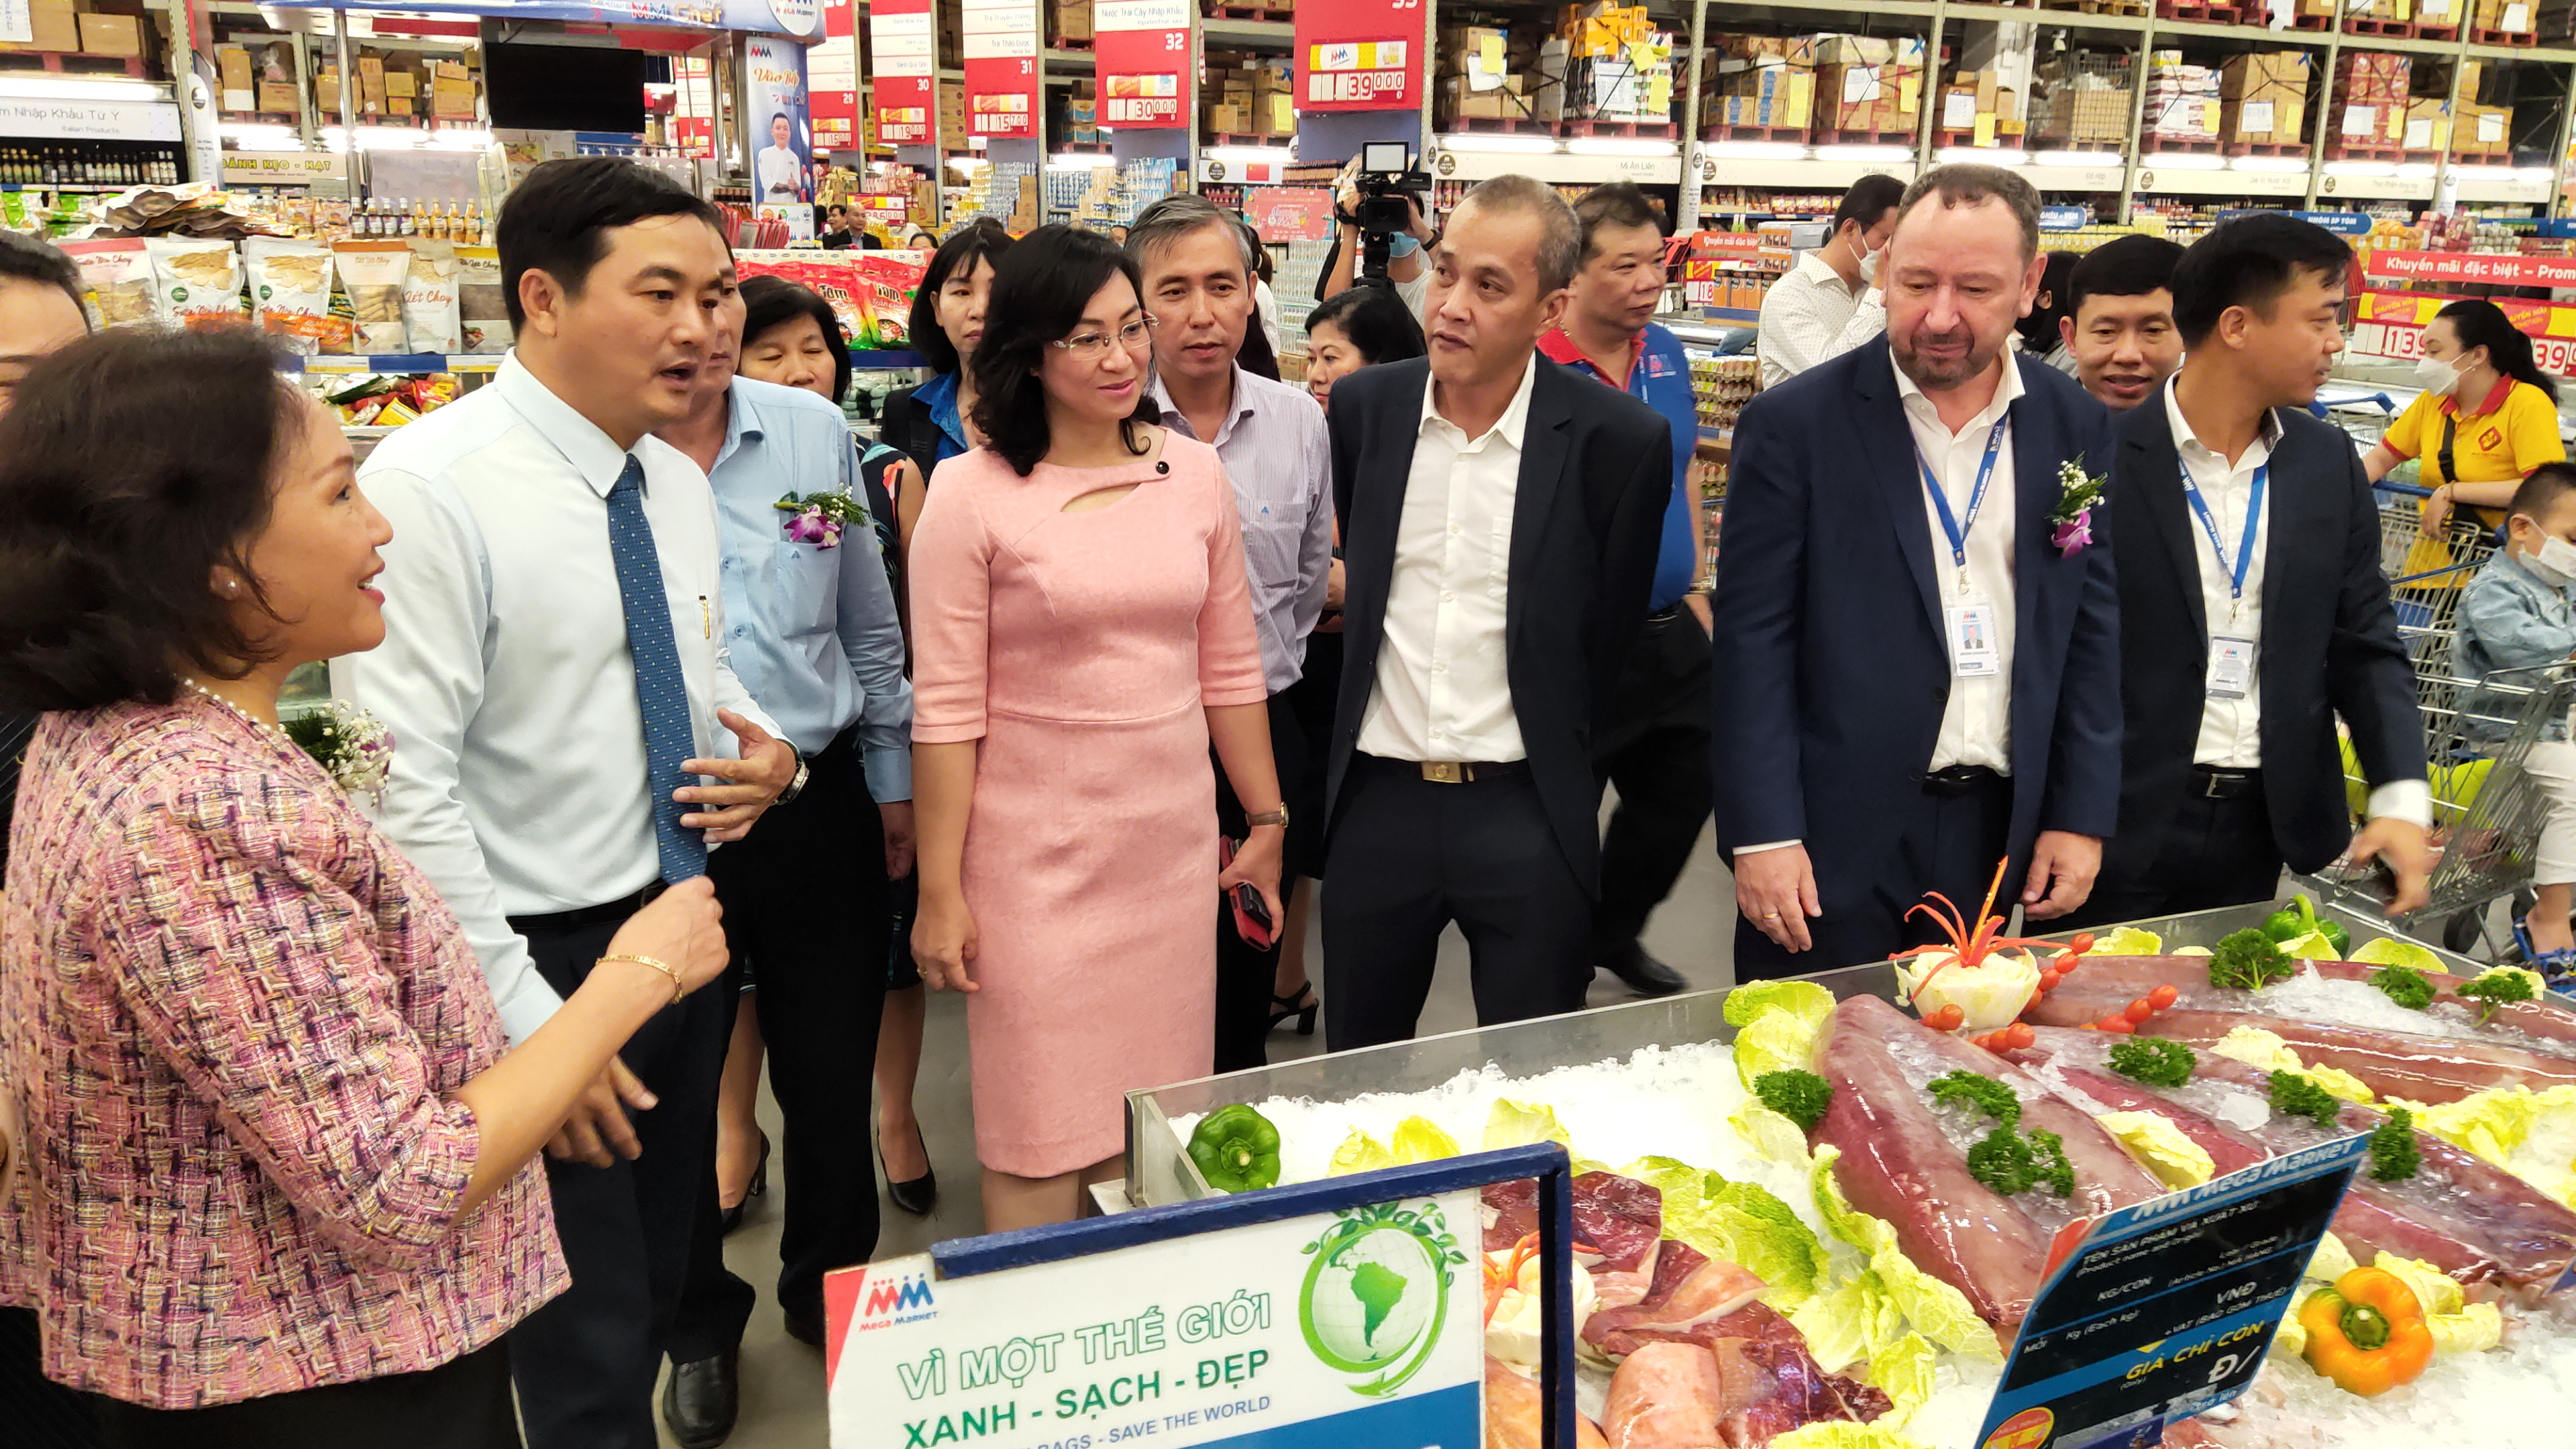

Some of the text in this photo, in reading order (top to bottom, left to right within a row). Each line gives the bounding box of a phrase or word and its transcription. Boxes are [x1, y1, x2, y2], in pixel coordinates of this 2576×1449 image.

[1165, 32, 1184, 50] 32
[1020, 60, 1032, 74] 31
[917, 78, 929, 91] 30
[843, 93, 853, 104] 29
[263, 159, 289, 172] KẸO
[305, 160, 331, 172] HẠT
[2386, 256, 2434, 272] Khuyến
[2437, 258, 2460, 273] mãi
[2463, 260, 2488, 277] đặc
[2492, 262, 2520, 280] biệt
[427, 288, 452, 308] Chay
[2194, 1165, 2263, 1201] Mega
[2262, 1140, 2358, 1178] Market
[865, 1274, 934, 1318] MM
[2216, 1281, 2257, 1304] VNĐ
[896, 1288, 1271, 1401] VÌ MỘT THẾ GIỚI
[2126, 1320, 2266, 1380] GIÁ CHỈ CÒN
[903, 1348, 1270, 1449] XANH - SẠCH - ĐẸP
[1109, 1419, 1157, 1444] SAVE
[1163, 1410, 1199, 1432] THE
[1203, 1395, 1271, 1422] WORLD
